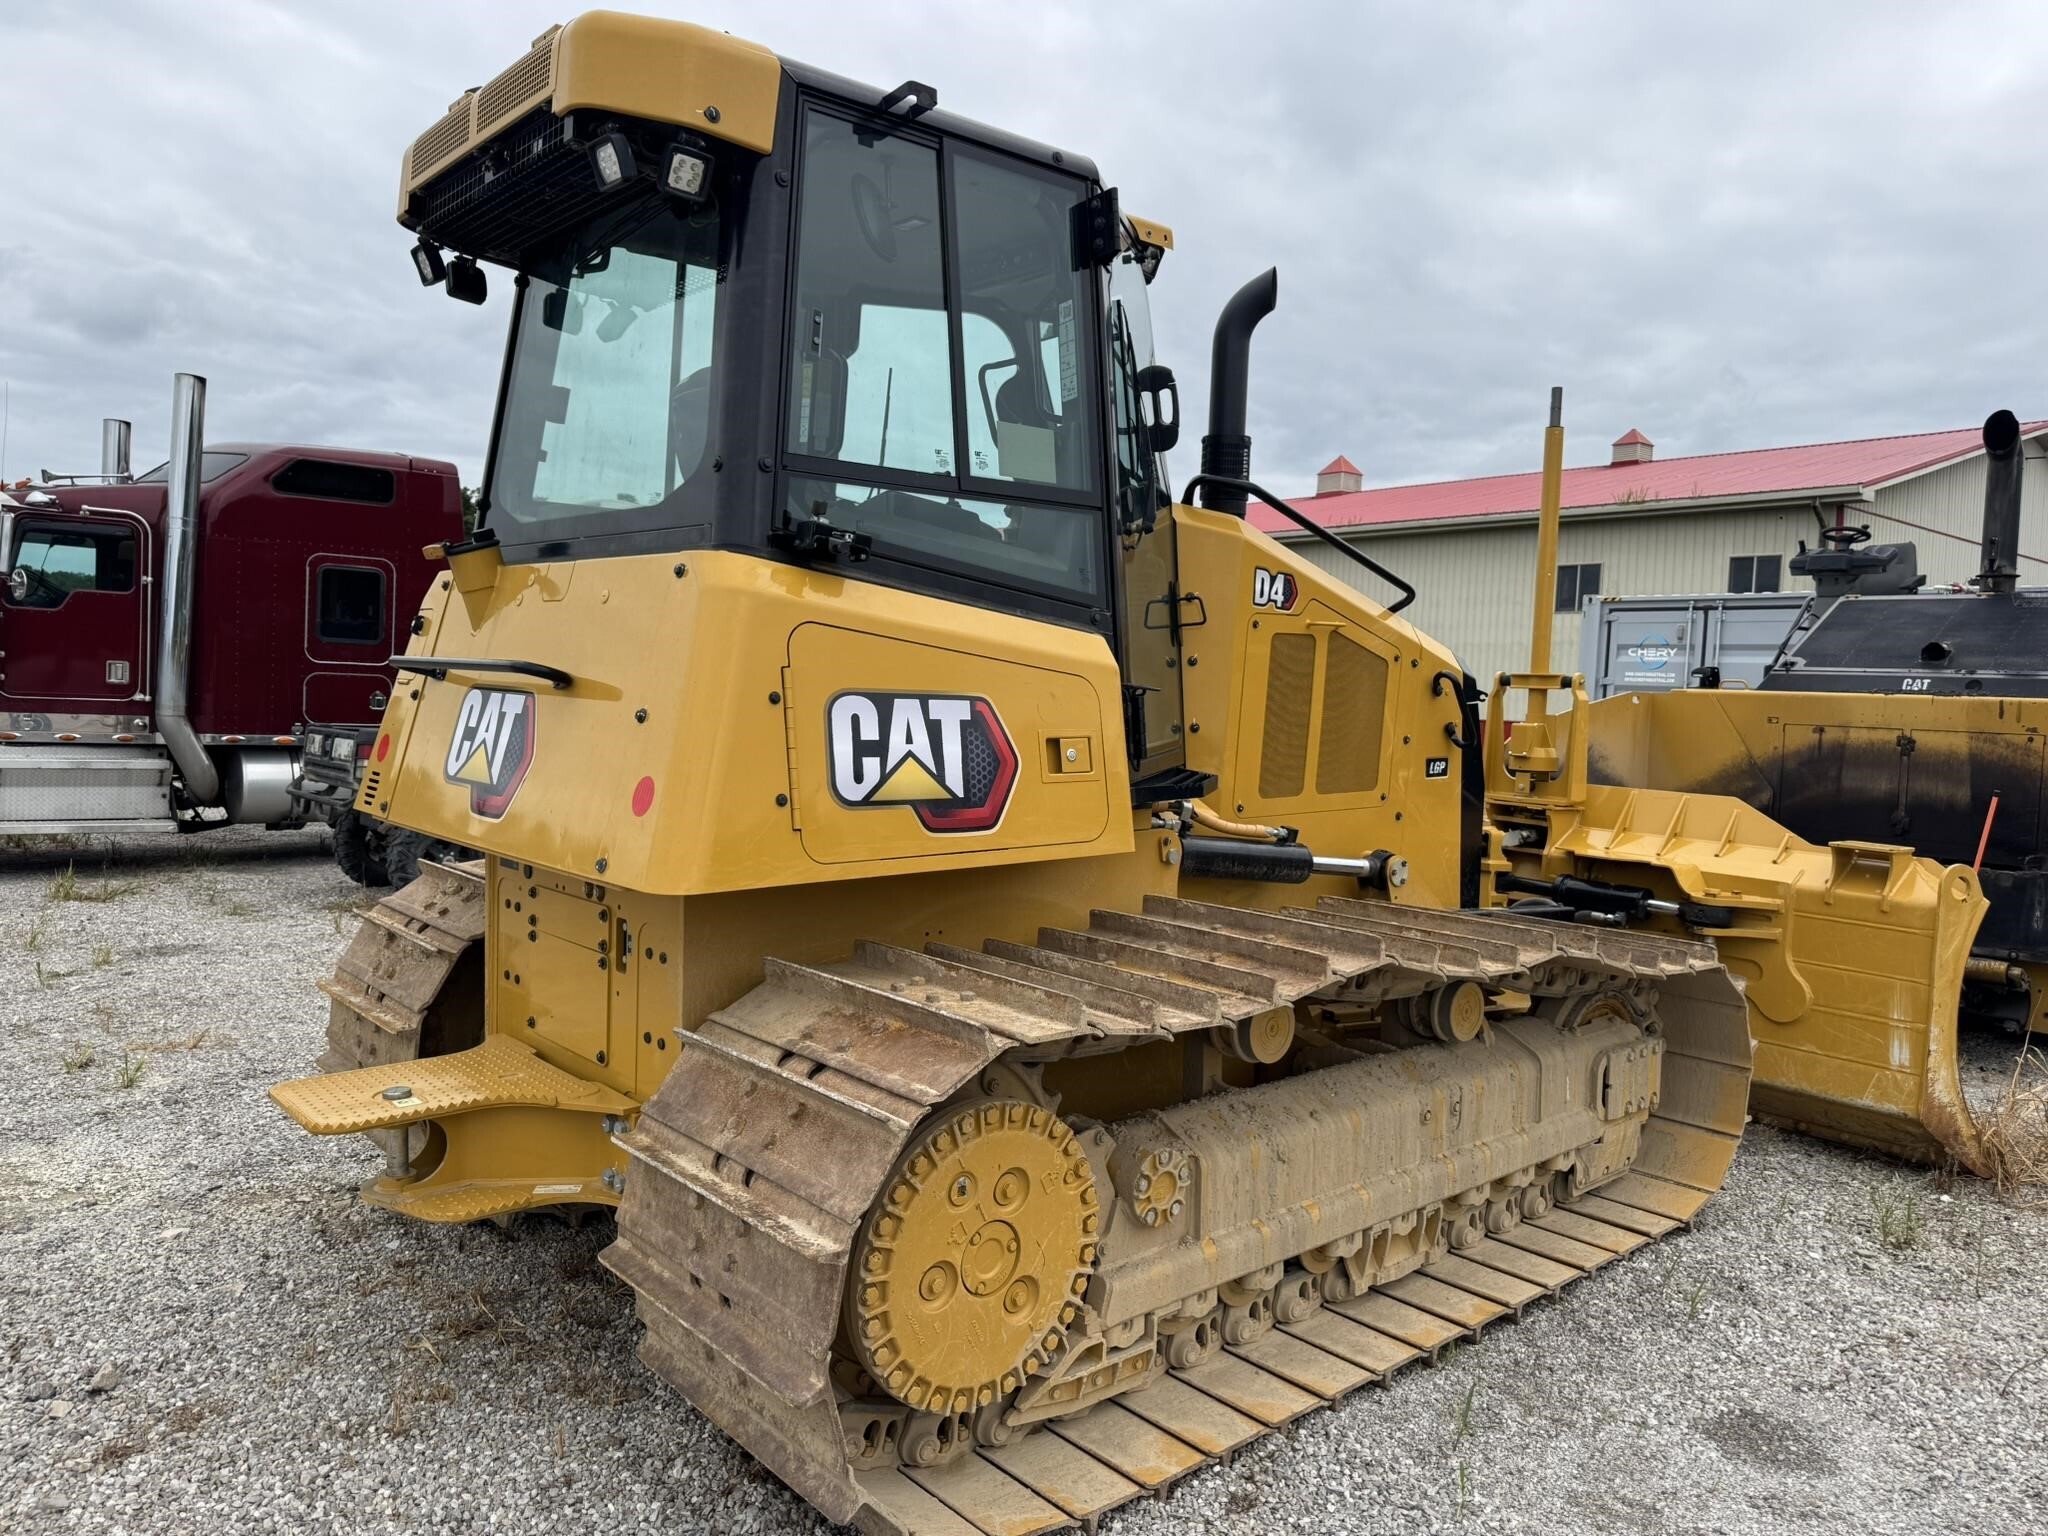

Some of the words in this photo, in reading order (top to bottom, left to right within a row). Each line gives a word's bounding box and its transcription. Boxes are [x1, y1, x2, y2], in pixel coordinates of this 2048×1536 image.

[1254, 569, 1285, 608] D4
[1628, 648, 1678, 657] CHERY
[1902, 678, 1932, 690] CAT
[447, 689, 526, 785] CAT
[832, 695, 971, 802] CAT
[1429, 761, 1446, 774] LGP
